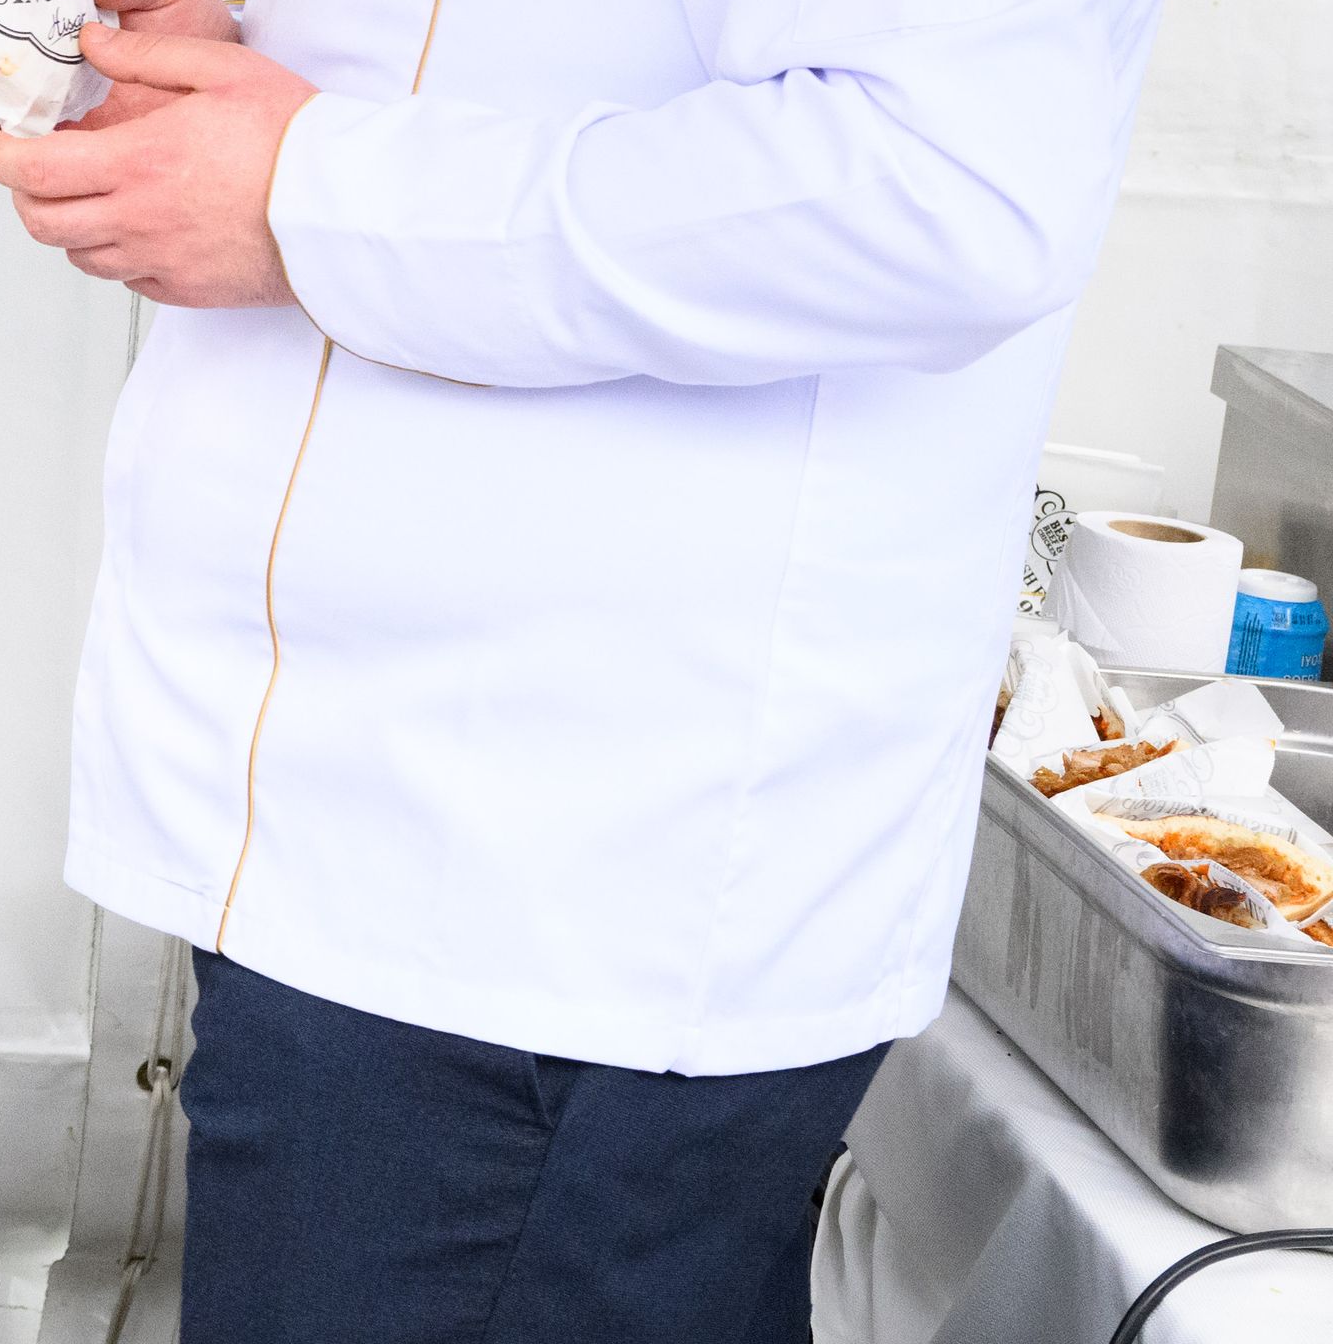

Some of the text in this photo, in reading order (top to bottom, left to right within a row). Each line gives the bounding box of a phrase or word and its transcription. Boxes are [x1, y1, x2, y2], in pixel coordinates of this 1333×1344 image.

[1037, 528, 1057, 557] CHICKEN
[1042, 524, 1059, 546] BEEF
[1050, 519, 1069, 544] BES
